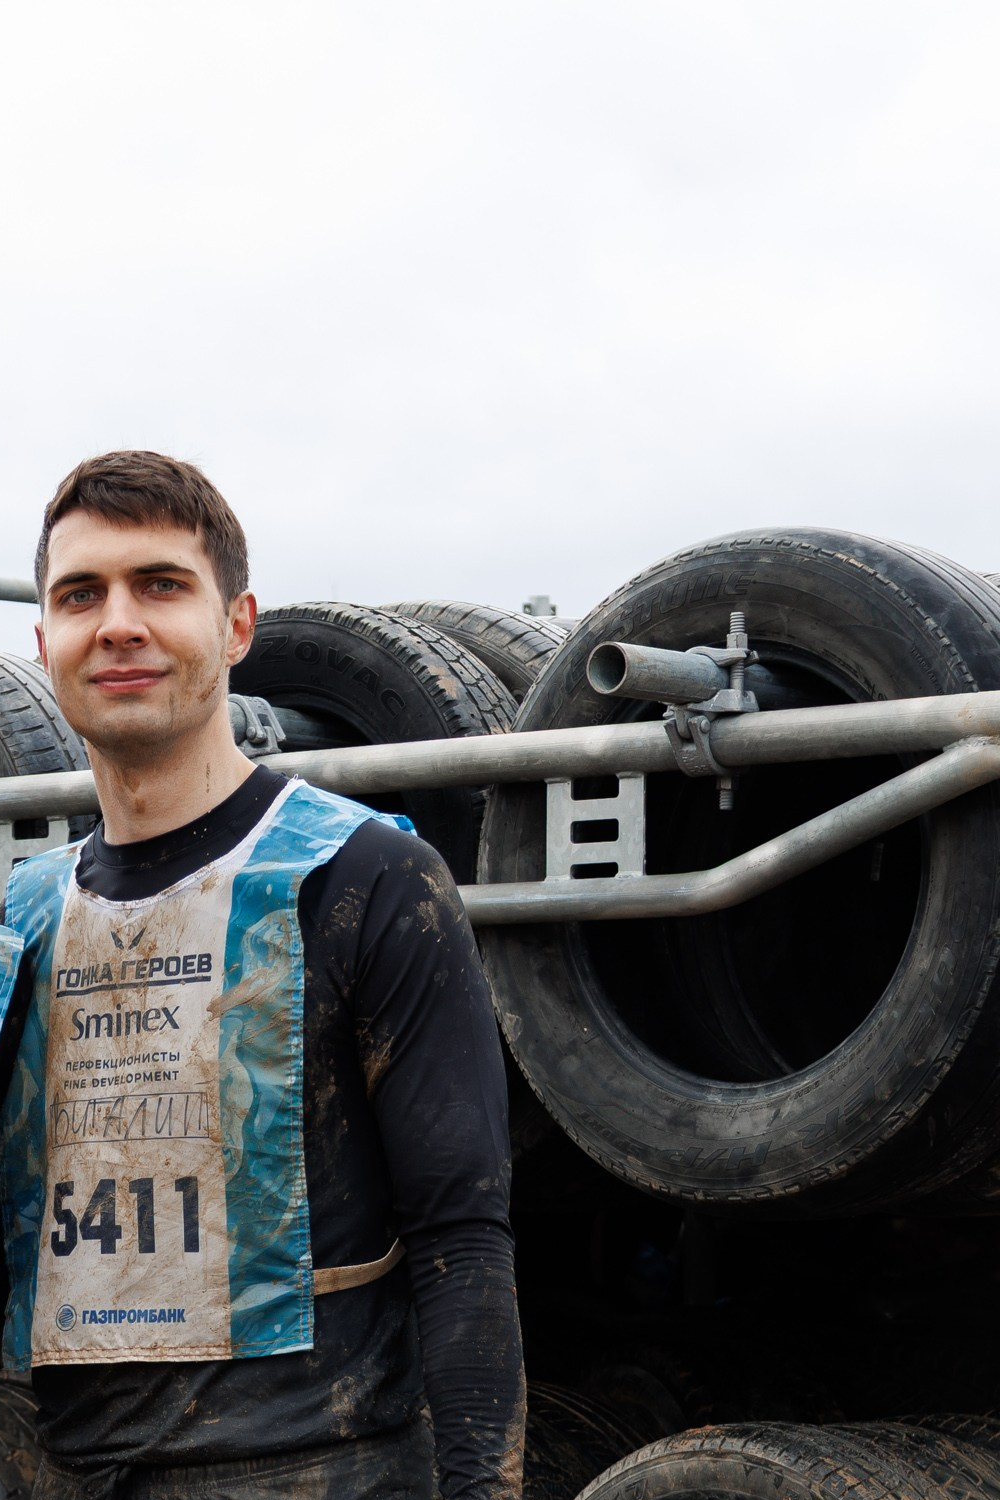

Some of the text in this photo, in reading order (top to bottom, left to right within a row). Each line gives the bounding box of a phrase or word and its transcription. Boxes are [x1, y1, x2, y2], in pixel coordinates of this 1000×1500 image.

[56, 952, 212, 990] ГОНКА ГЕРОЕВ
[69, 1003, 180, 1042] Sminex
[65, 1051, 181, 1072] ПЕРФЕКЦИОНИСТЫ
[63, 1070, 180, 1091] FINE DEVELOPMENT
[51, 1175, 200, 1258] 5411
[81, 1308, 187, 1325] ГАЗПРОМБАНК
